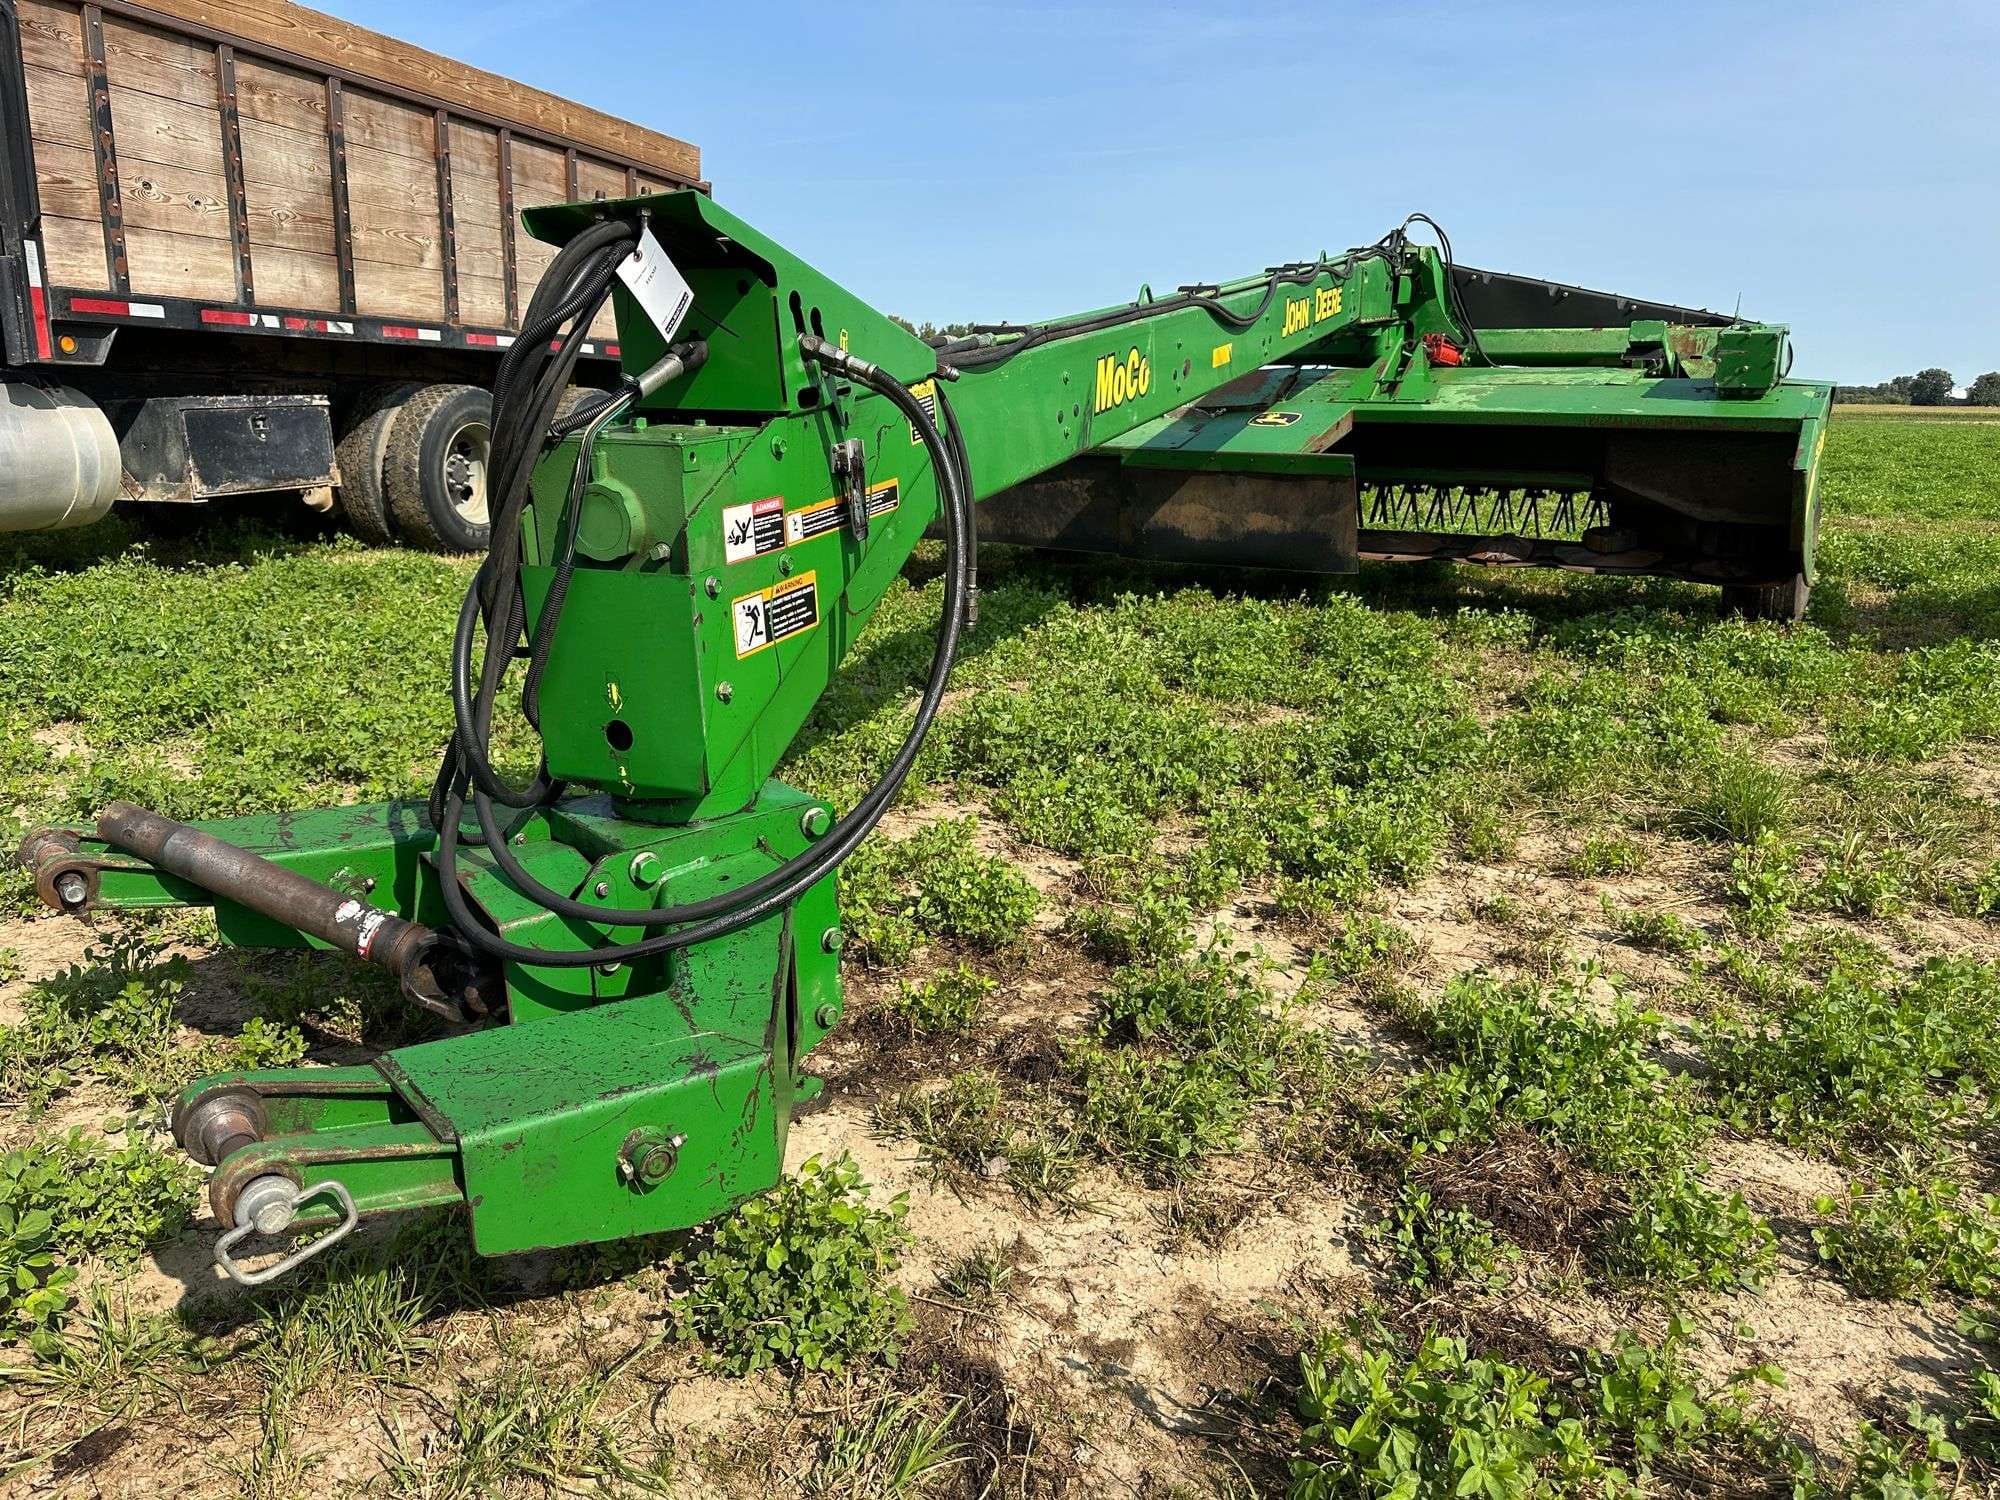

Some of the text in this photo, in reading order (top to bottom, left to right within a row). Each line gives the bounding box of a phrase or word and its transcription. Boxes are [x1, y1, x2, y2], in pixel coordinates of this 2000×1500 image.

[1282, 286, 1343, 338] JOHN DEERE
[1094, 345, 1150, 416] MoCo
[759, 500, 780, 511] DANGER
[780, 577, 803, 592] WARNING
